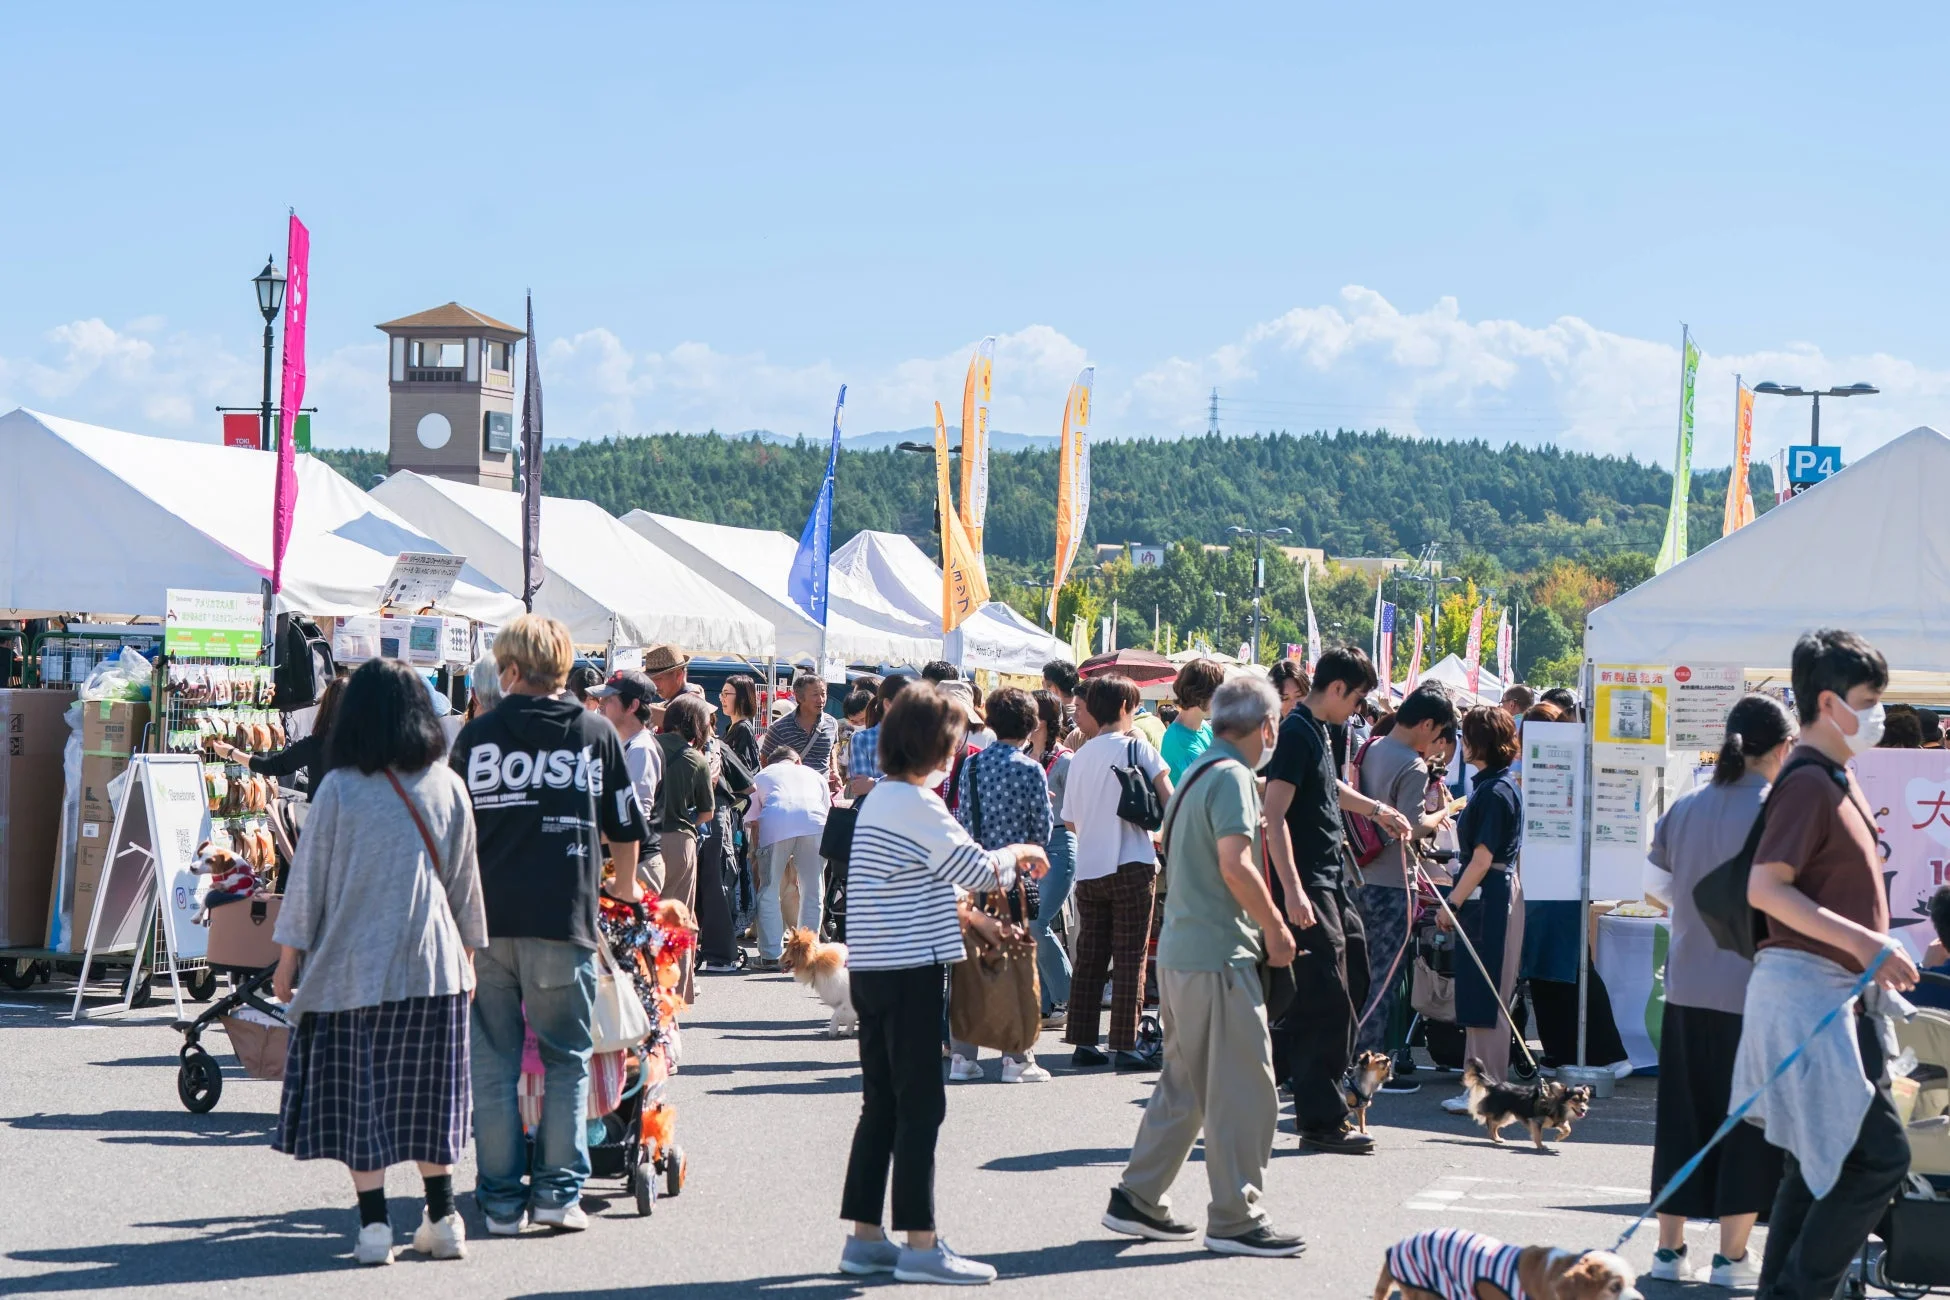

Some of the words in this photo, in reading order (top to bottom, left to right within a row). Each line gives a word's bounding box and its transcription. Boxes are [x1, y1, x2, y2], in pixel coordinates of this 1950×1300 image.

[1795, 450, 1835, 478] P4
[1601, 671, 1663, 684] 新製品発売
